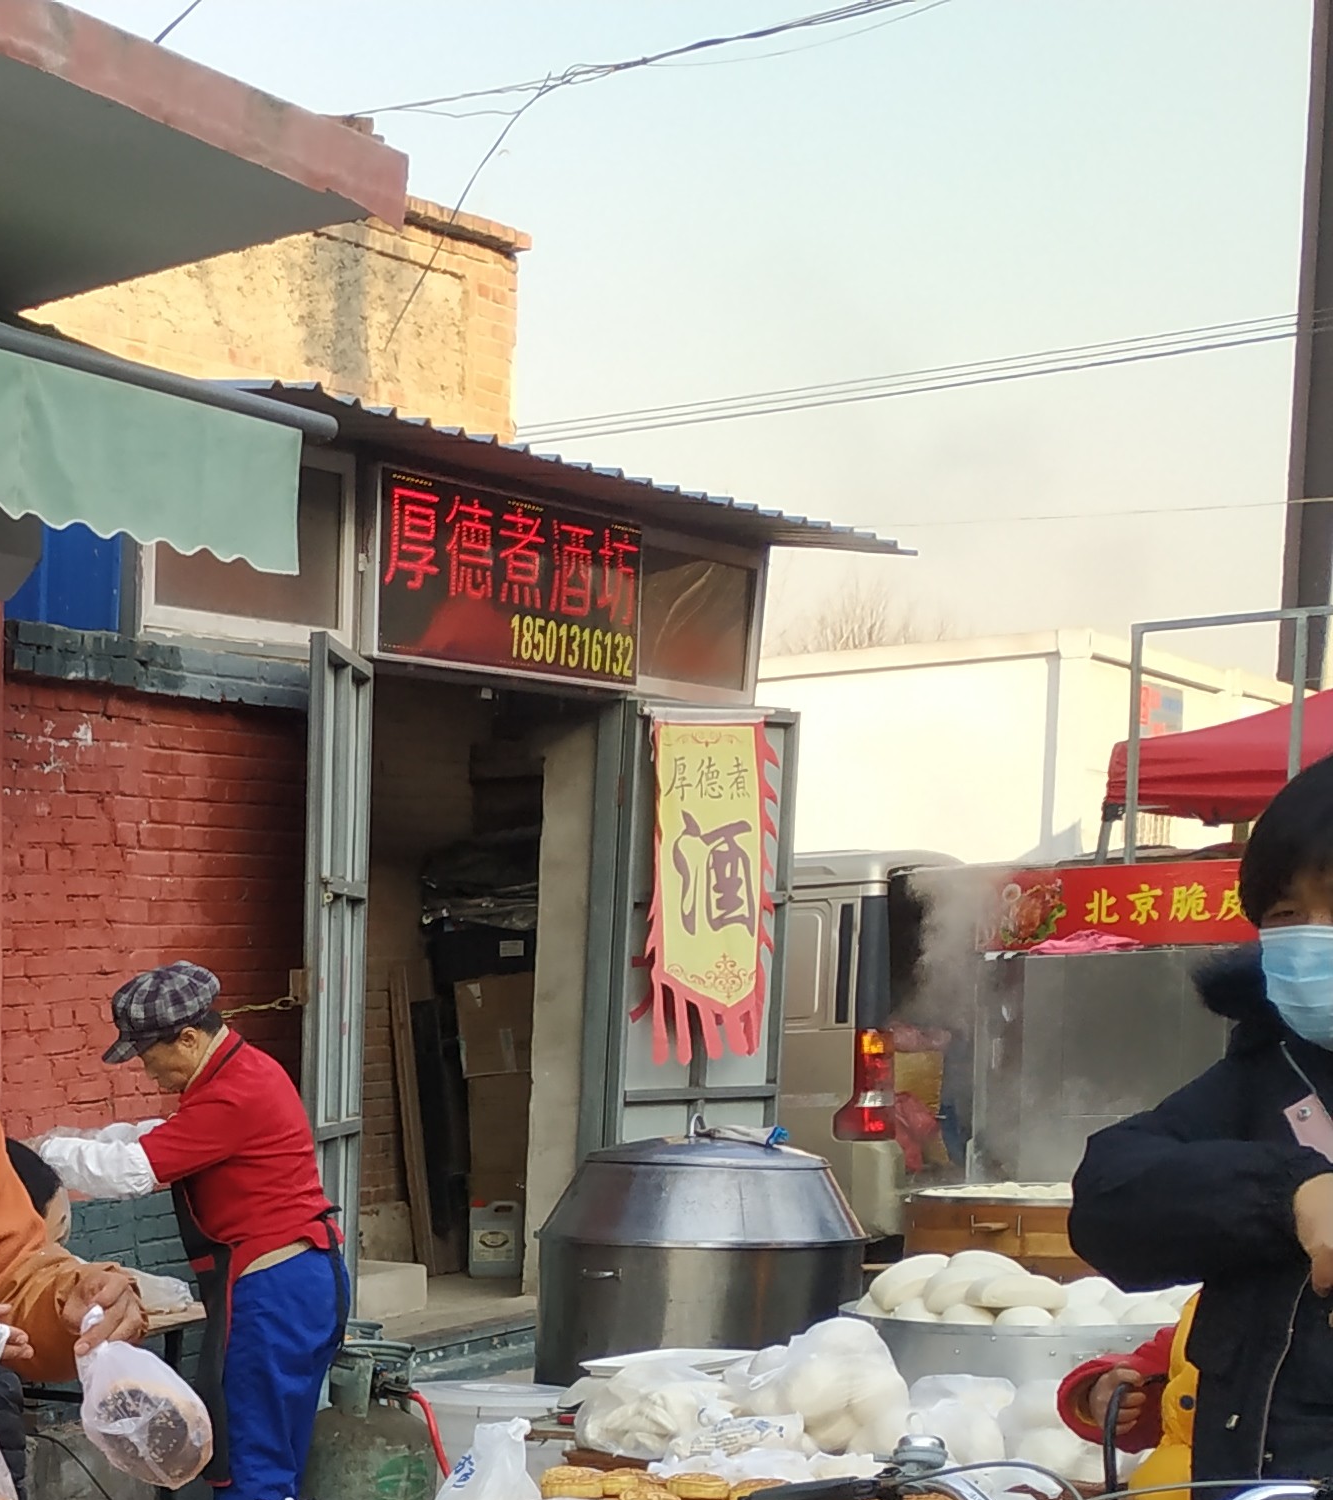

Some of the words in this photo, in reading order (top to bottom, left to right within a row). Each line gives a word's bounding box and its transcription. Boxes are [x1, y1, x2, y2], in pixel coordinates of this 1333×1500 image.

[383, 486, 640, 627] 厚德煮酒坊
[510, 613, 634, 678] 18501316132
[664, 755, 752, 802] 厚德煮
[672, 810, 757, 938] 酒
